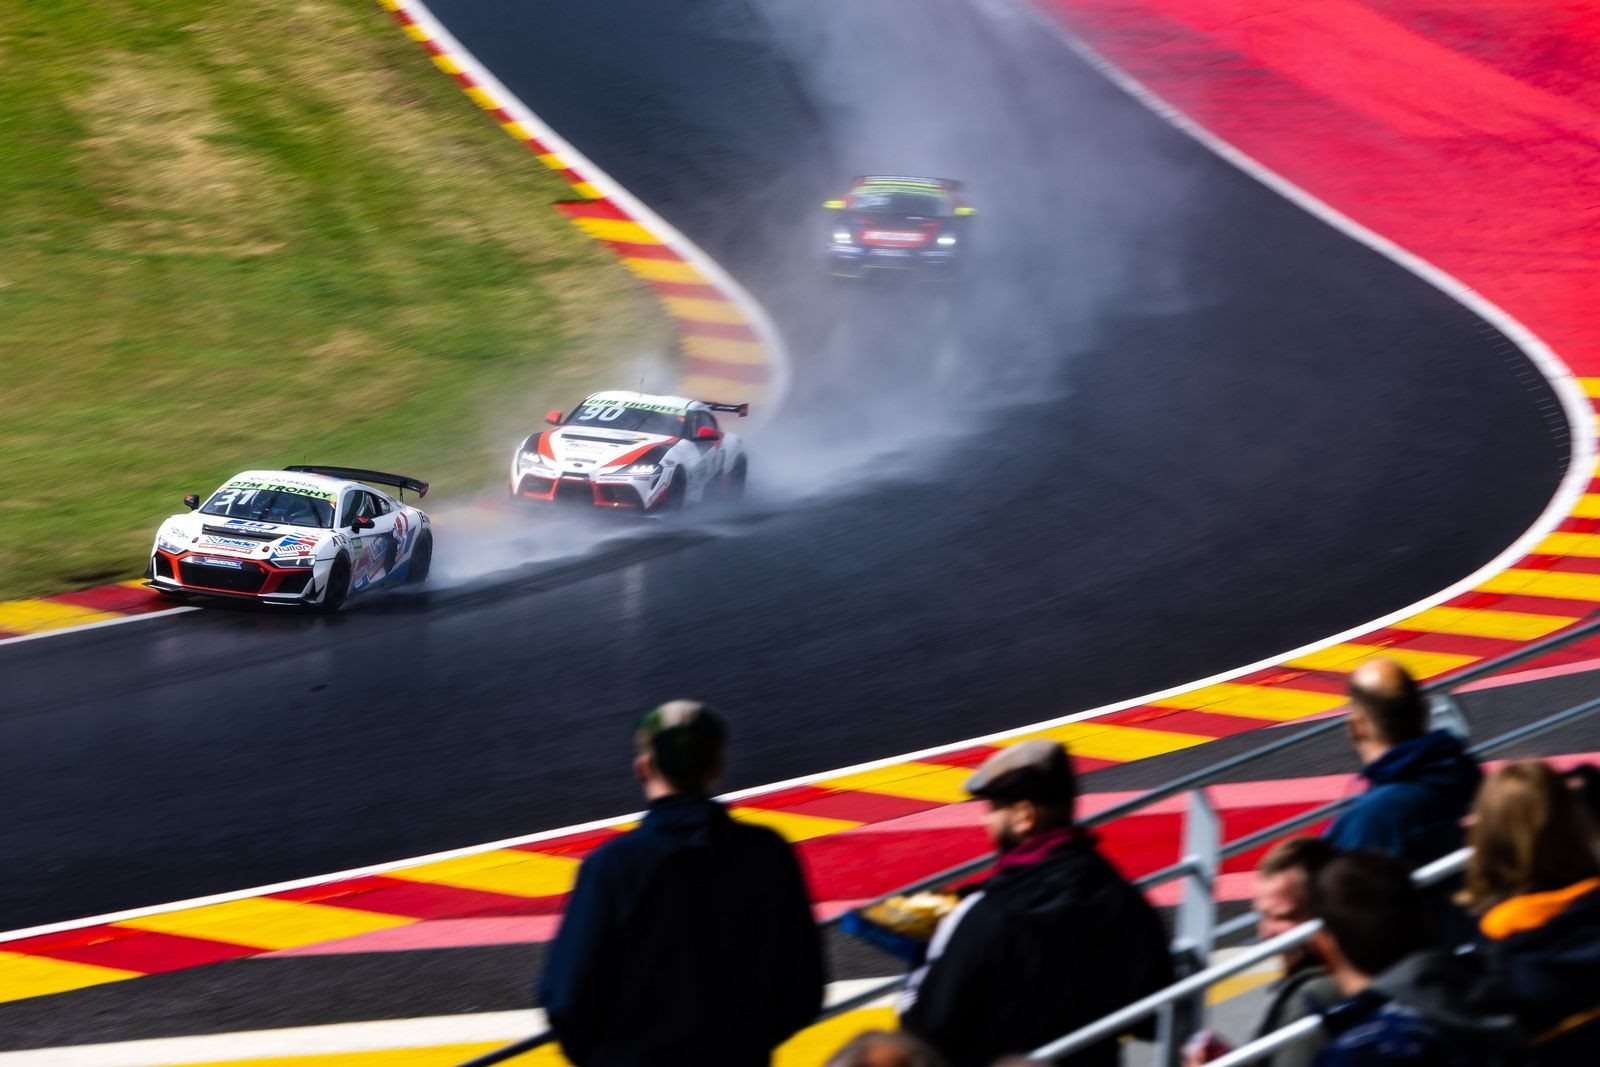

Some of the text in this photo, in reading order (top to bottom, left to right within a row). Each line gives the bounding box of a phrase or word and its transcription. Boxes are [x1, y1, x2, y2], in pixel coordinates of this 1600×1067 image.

[578, 406, 626, 421] 90
[622, 401, 681, 413] TROPHY
[214, 488, 258, 506] 31
[229, 481, 332, 499] DTM TROPHY
